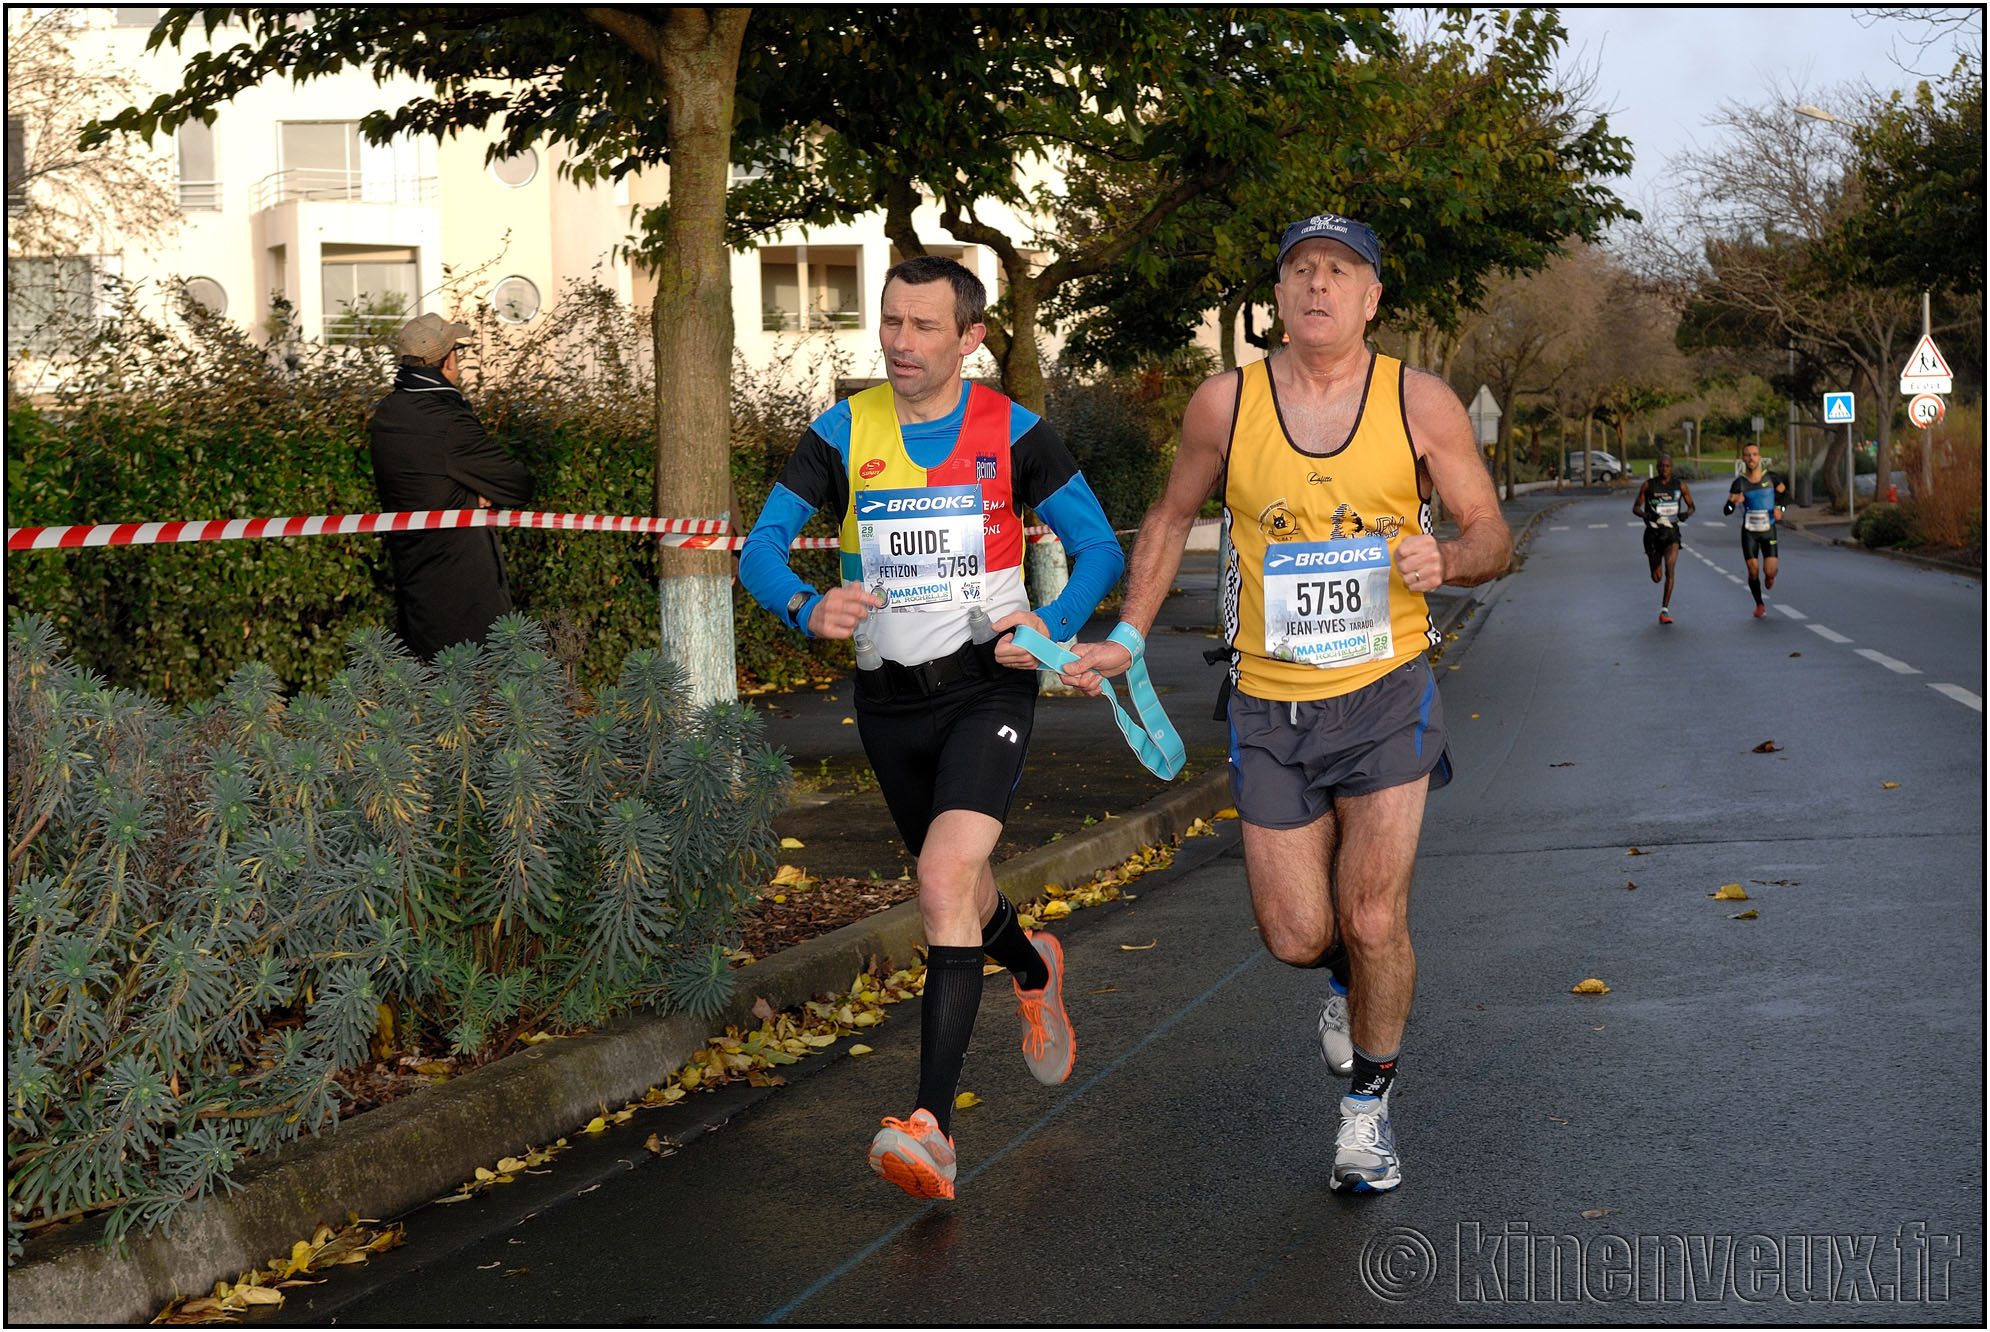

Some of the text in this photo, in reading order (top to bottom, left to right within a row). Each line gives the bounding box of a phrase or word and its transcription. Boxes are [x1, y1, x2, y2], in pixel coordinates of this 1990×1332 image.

[1918, 404, 1937, 417] 30
[886, 494, 976, 512] BROOKS
[862, 526, 874, 534] 29
[890, 529, 950, 556] GUIDE
[937, 554, 978, 578] 5759
[1295, 547, 1384, 567] BROOKS
[879, 564, 918, 578] FETIZON
[890, 583, 948, 598] MARATHON
[1296, 578, 1362, 617] 5758
[1286, 618, 1346, 636] JEAN-YVES
[1296, 634, 1366, 656] MARATHON
[1374, 636, 1388, 647] 29
